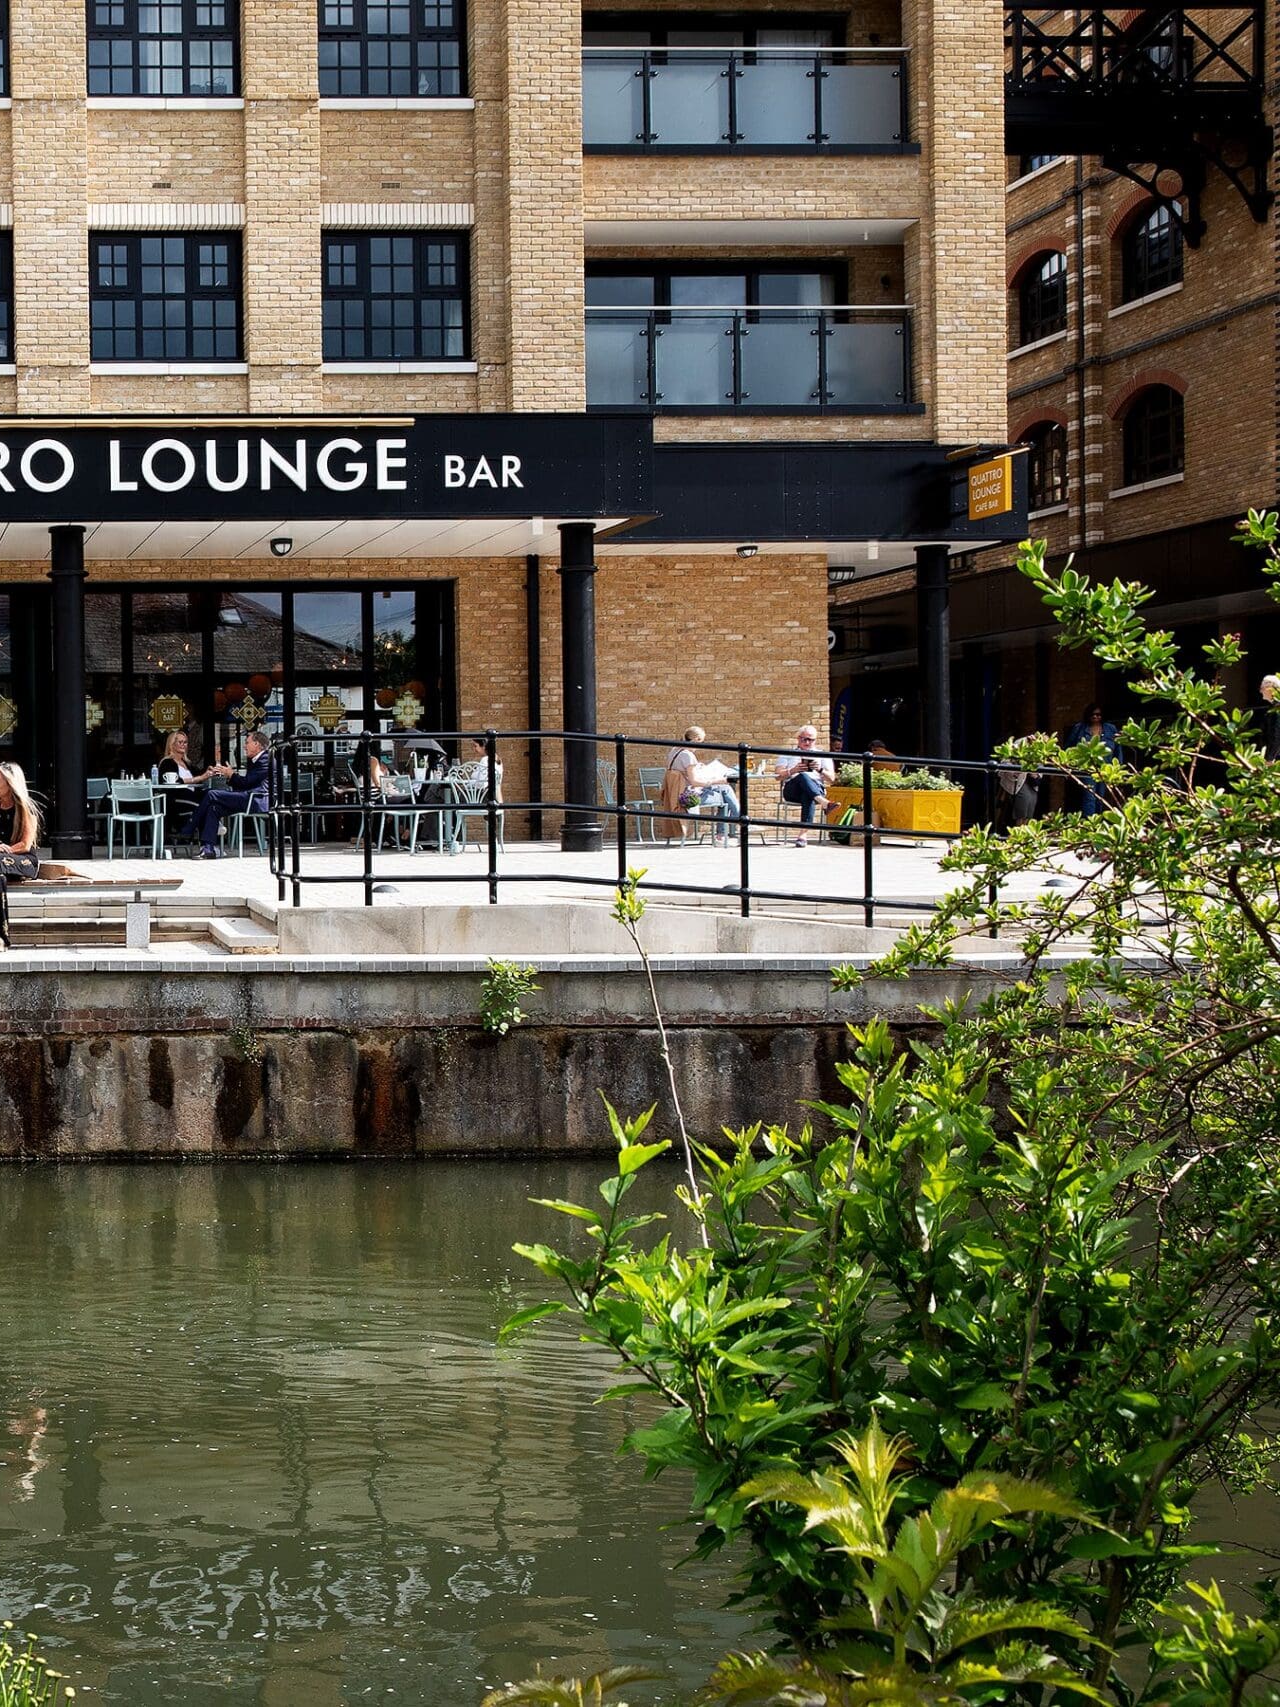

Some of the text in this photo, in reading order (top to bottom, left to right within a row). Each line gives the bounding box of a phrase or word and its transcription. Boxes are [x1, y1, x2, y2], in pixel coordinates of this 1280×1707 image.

[110, 438, 407, 492] LOUNGE
[445, 455, 523, 487] BAR
[970, 467, 1003, 487] QUATTRO
[972, 482, 1001, 500] LOUNGE
[988, 499, 999, 509] BAR
